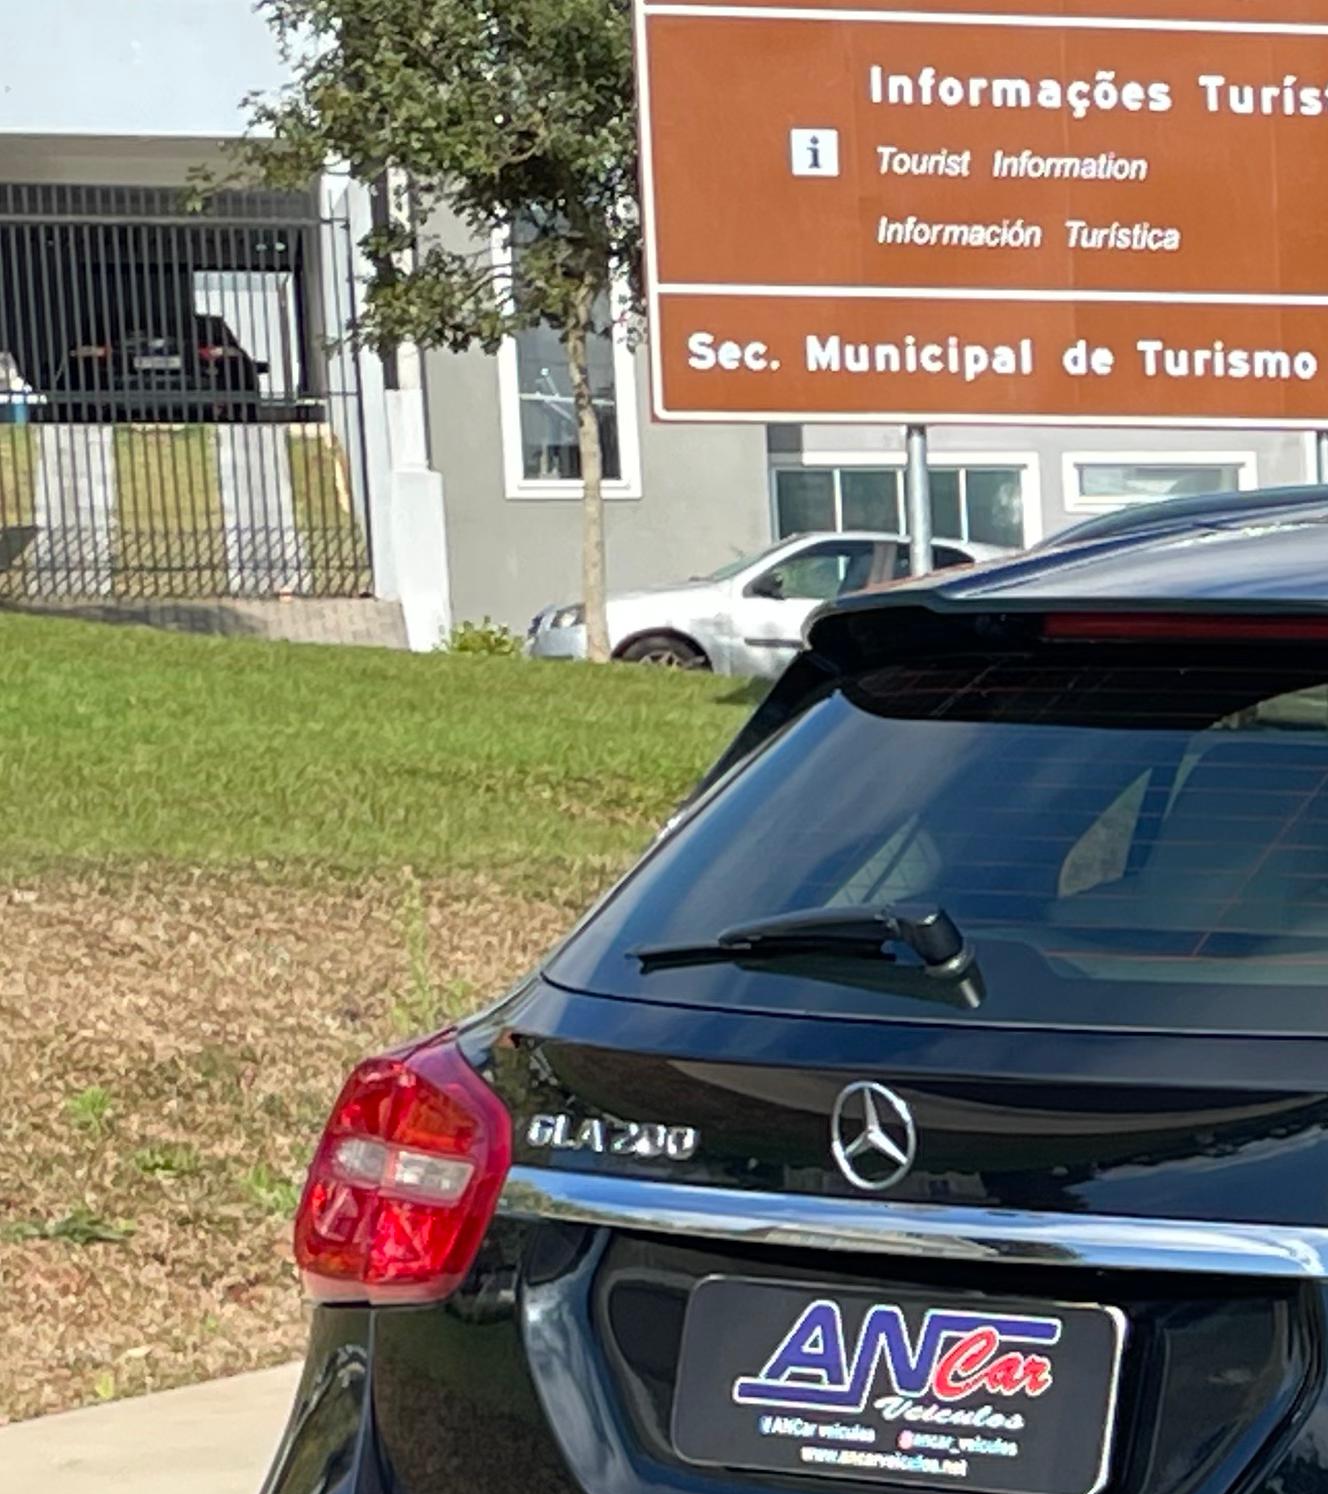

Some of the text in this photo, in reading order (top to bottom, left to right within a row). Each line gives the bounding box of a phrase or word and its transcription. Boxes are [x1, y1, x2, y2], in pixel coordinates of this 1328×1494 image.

[869, 64, 1172, 119] Informações
[876, 145, 1148, 181] Tourist Information
[876, 215, 1181, 251] Información Turística
[688, 331, 780, 371] Sec.
[805, 335, 1033, 382] Municipal
[1062, 339, 1115, 376] de
[1136, 340, 1318, 380] Turismo
[527, 1114, 699, 1160] GLA 200
